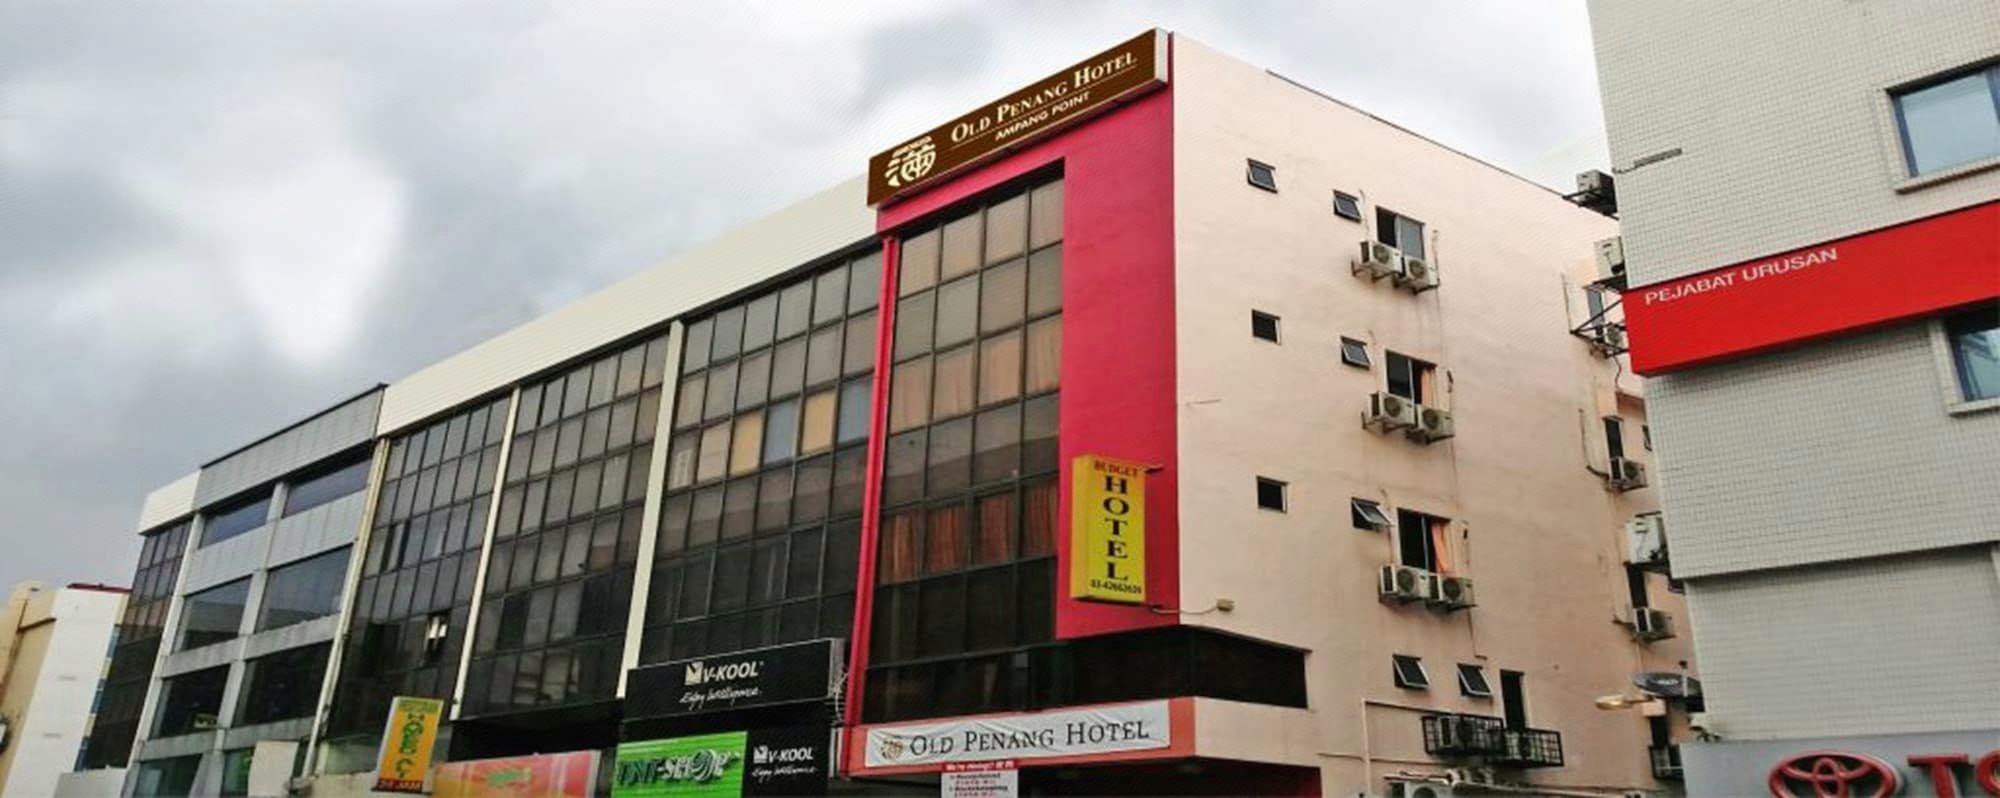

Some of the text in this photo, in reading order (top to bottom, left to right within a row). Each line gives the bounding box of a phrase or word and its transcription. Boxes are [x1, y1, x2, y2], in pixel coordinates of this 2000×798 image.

[951, 52, 1138, 143] OLD PENANG HOTEL
[995, 91, 1091, 140] AMPANG POINT
[1644, 248, 1839, 306] PEJABAT URUSAN
[1102, 475, 1130, 582] HOTEL
[703, 661, 759, 683] V-KOOL
[768, 746, 814, 763] V-KOOL
[909, 720, 1150, 757] OLD PENANG HOTEL
